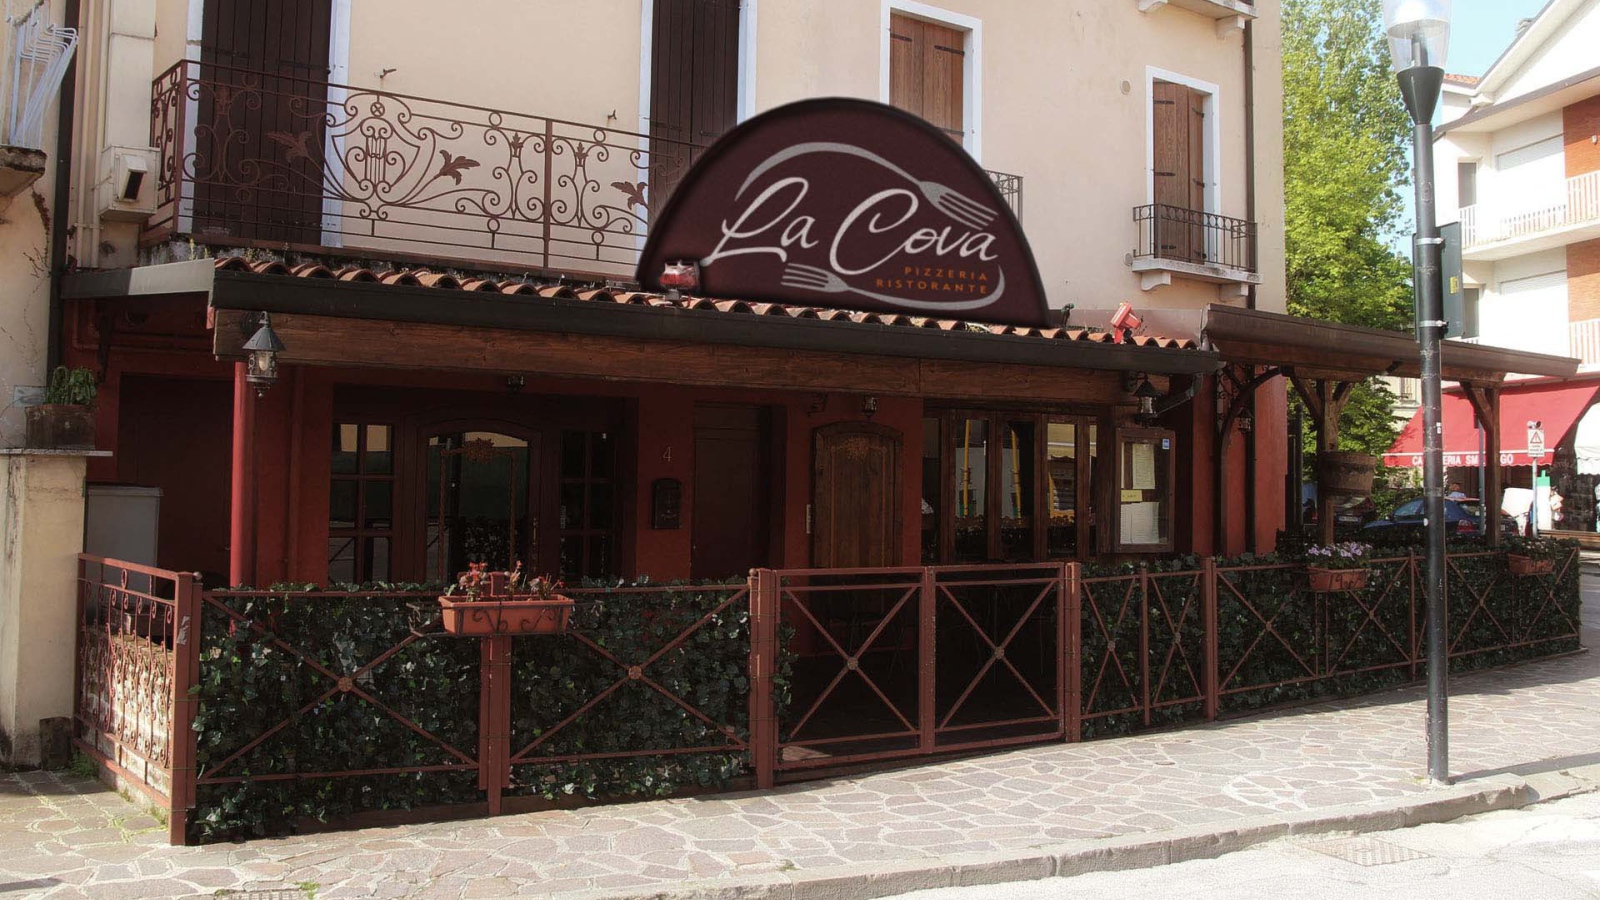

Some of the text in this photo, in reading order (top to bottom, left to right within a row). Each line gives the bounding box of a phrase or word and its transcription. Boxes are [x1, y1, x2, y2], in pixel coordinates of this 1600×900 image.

[700, 176, 999, 275] La Cova
[904, 265, 988, 281] PIZZERIA
[875, 278, 988, 294] RISTORANTE
[662, 446, 673, 462] 4
